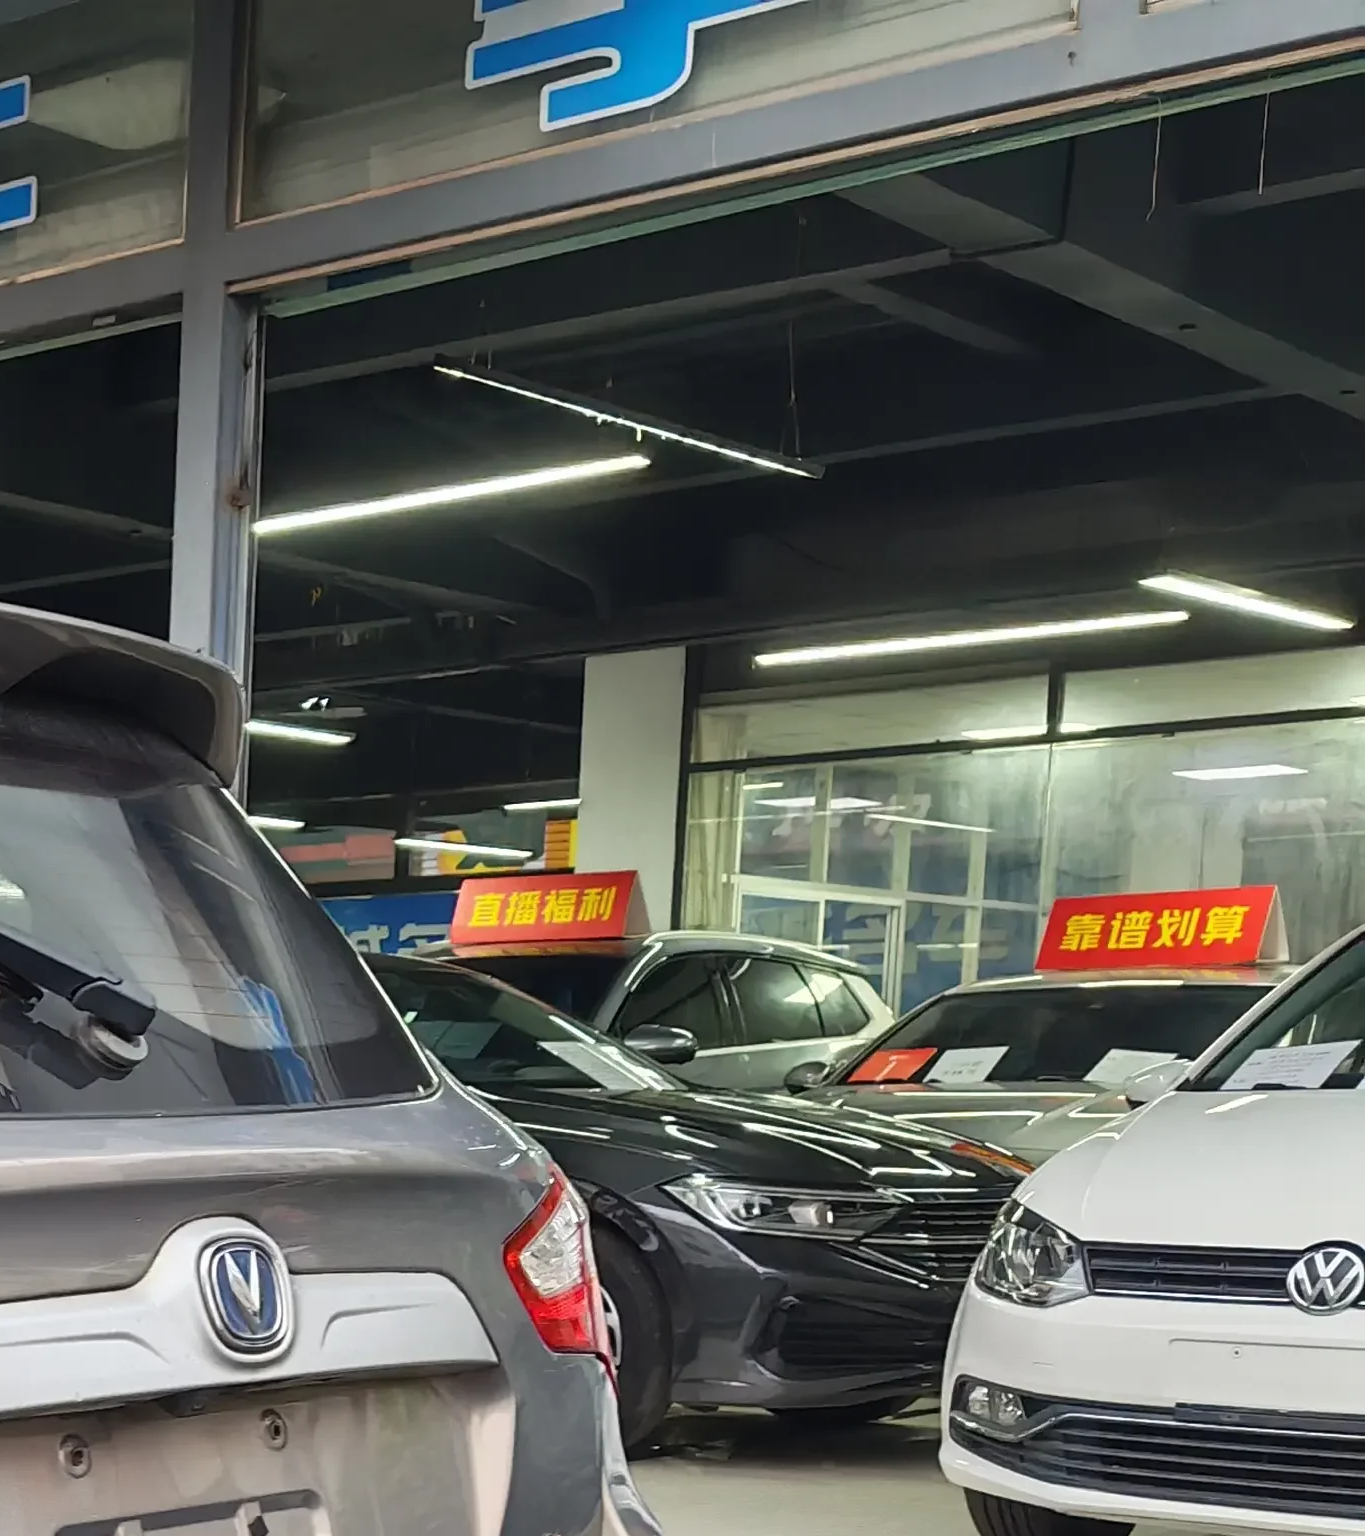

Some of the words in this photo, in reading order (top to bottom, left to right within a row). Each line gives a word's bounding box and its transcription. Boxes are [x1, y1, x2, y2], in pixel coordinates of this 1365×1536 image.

[468, 886, 618, 927] 直播福利
[1059, 905, 1250, 951] 靠谱划算
